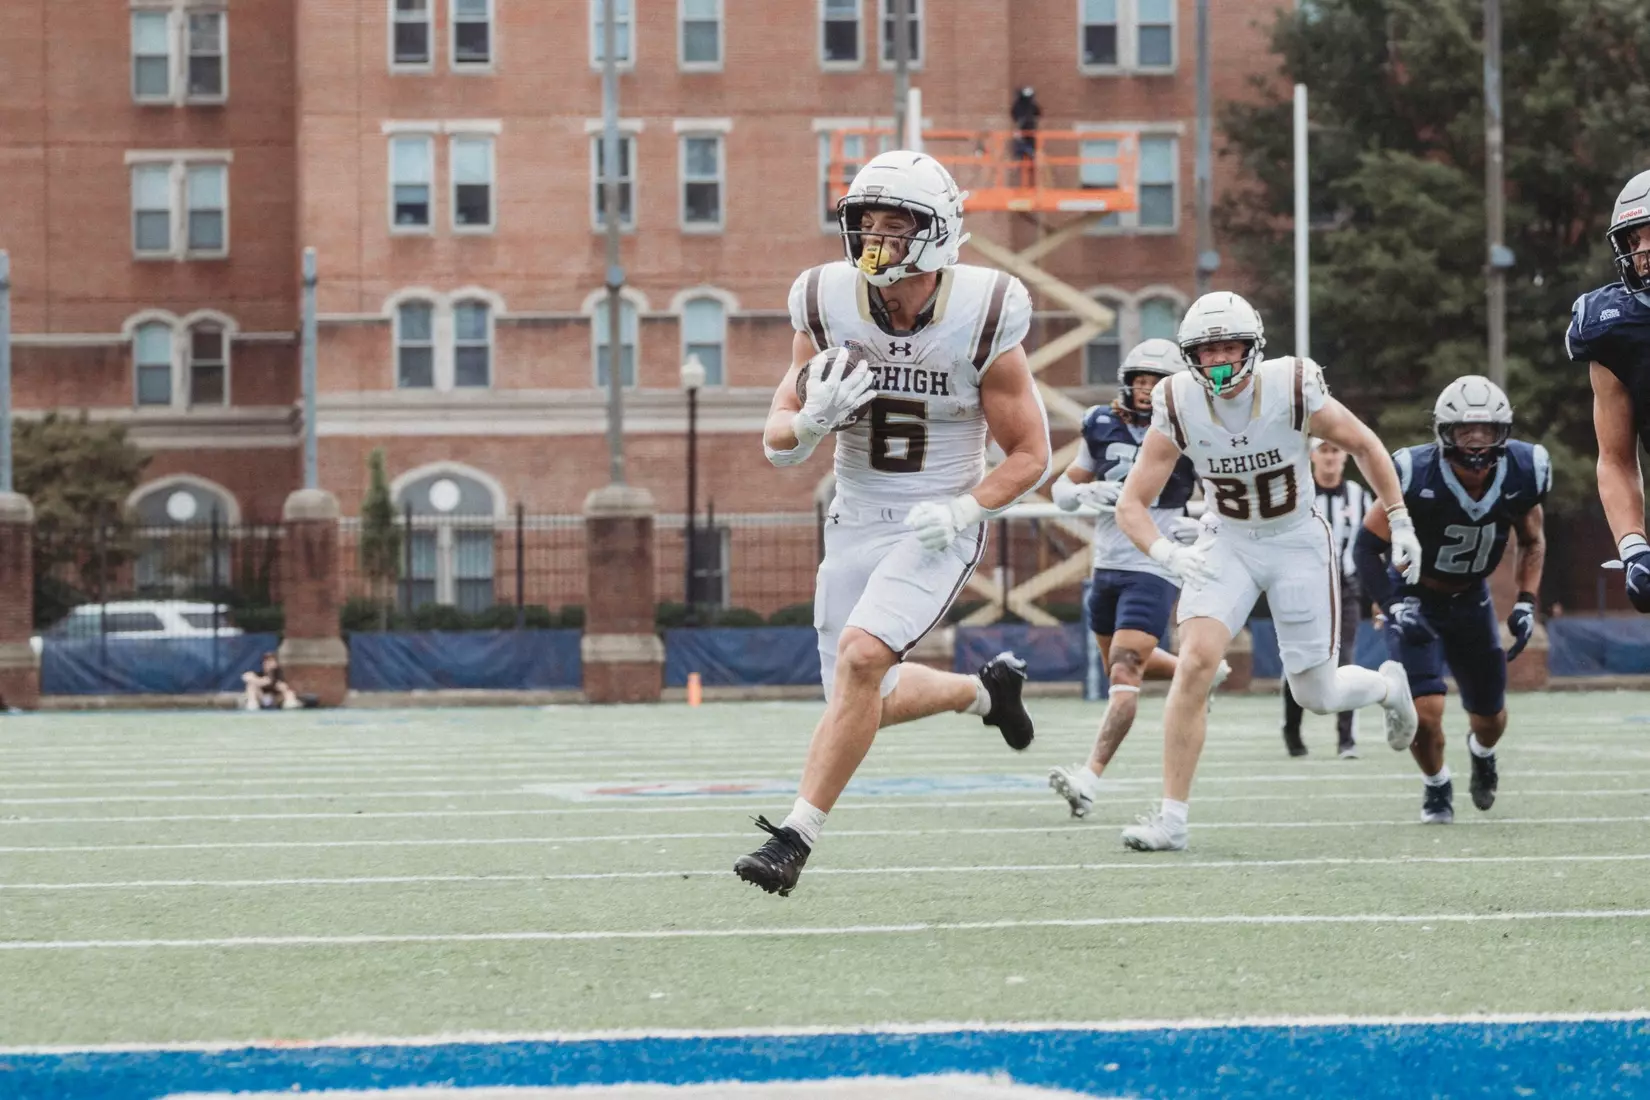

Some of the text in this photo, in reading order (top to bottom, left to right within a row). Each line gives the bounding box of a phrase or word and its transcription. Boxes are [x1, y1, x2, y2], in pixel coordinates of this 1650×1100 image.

[867, 366, 950, 396] EHIGH
[868, 396, 929, 473] 6
[1207, 448, 1284, 474] LEHIGH
[1201, 464, 1297, 520] 80
[1434, 522, 1496, 574] 21
